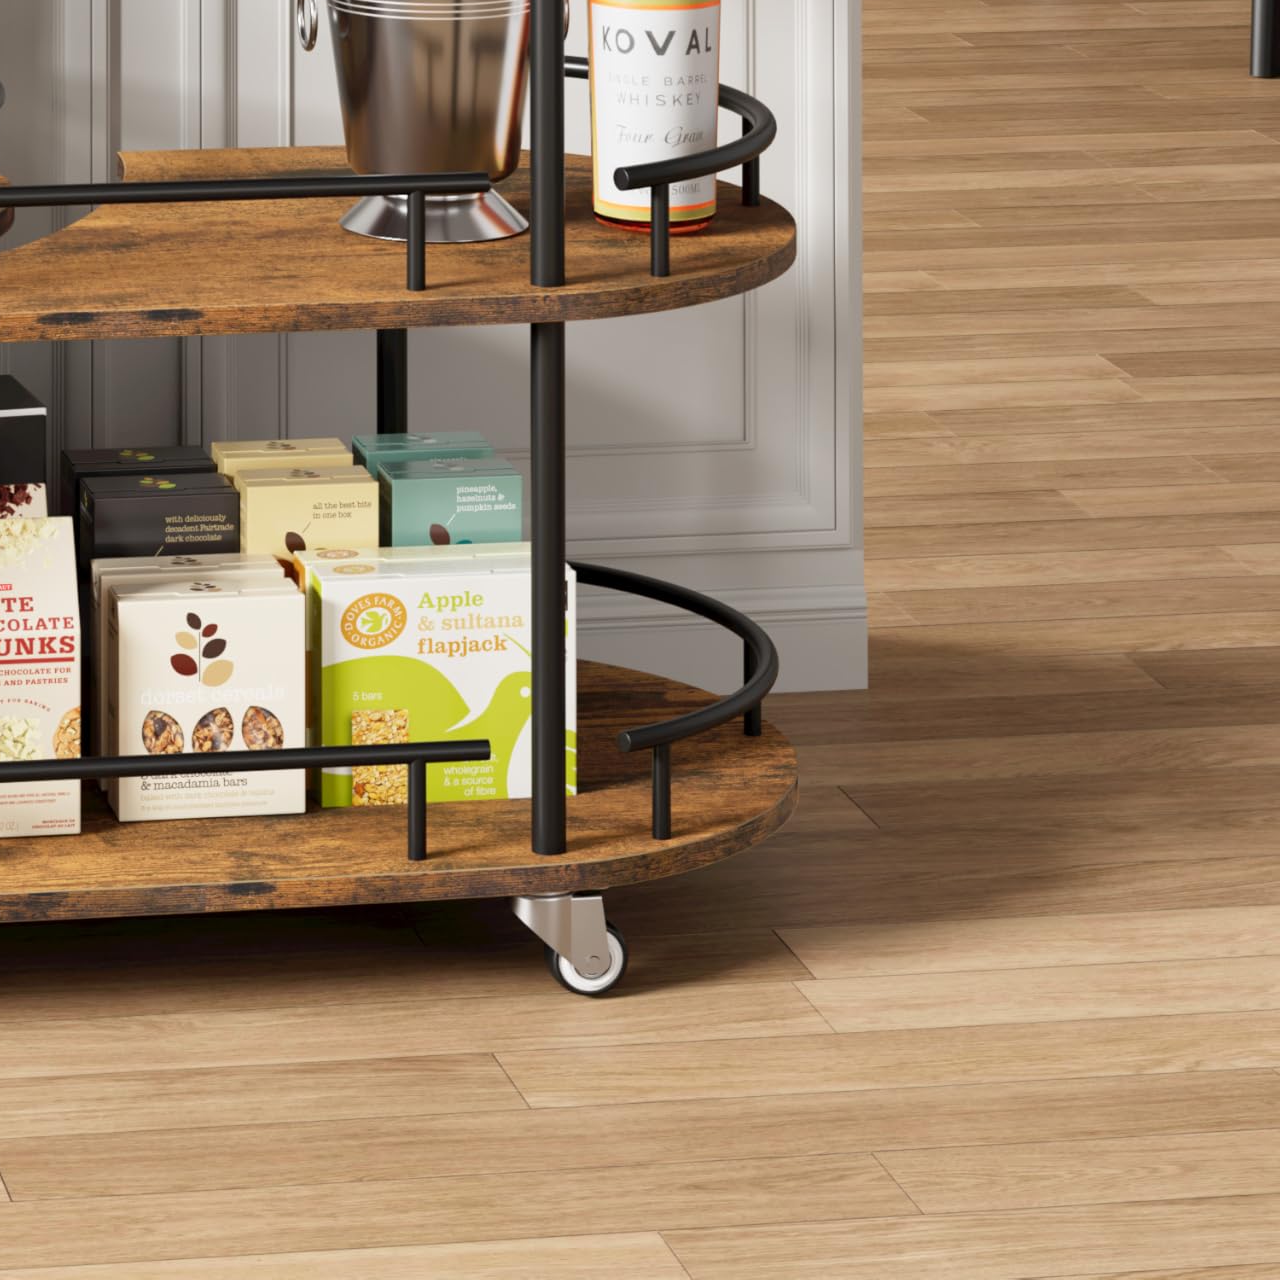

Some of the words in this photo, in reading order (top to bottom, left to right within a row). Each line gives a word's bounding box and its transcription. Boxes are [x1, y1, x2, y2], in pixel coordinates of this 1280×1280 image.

[602, 25, 712, 57] KOVAL
[616, 92, 702, 107] WHISKEY
[456, 484, 497, 494] pineapple,
[339, 501, 356, 509] best
[456, 503, 492, 512] pumpkin
[493, 502, 516, 510] seeds
[165, 515, 183, 523] with
[184, 514, 226, 523] deliciously
[338, 511, 352, 519] box
[165, 524, 199, 533] decadent
[200, 523, 235, 532] Fairtrade
[165, 535, 184, 543] dark
[185, 534, 223, 542] chocolate
[418, 591, 484, 612] Apple
[345, 598, 372, 631] DOVES
[374, 596, 403, 617] FARM
[418, 615, 434, 631] &
[441, 613, 524, 631] sultana
[351, 620, 403, 647] ORGANIC
[417, 635, 507, 657] flapjack
[25, 677, 69, 685] PASTRIES
[352, 691, 360, 700] 5
[361, 691, 383, 700] bars
[444, 765, 494, 776] wholegrain
[140, 780, 151, 791] &
[153, 779, 221, 791] macadamia
[223, 777, 248, 787] bars
[461, 777, 494, 785] source
[464, 786, 474, 796] of
[475, 786, 496, 795] fibre
